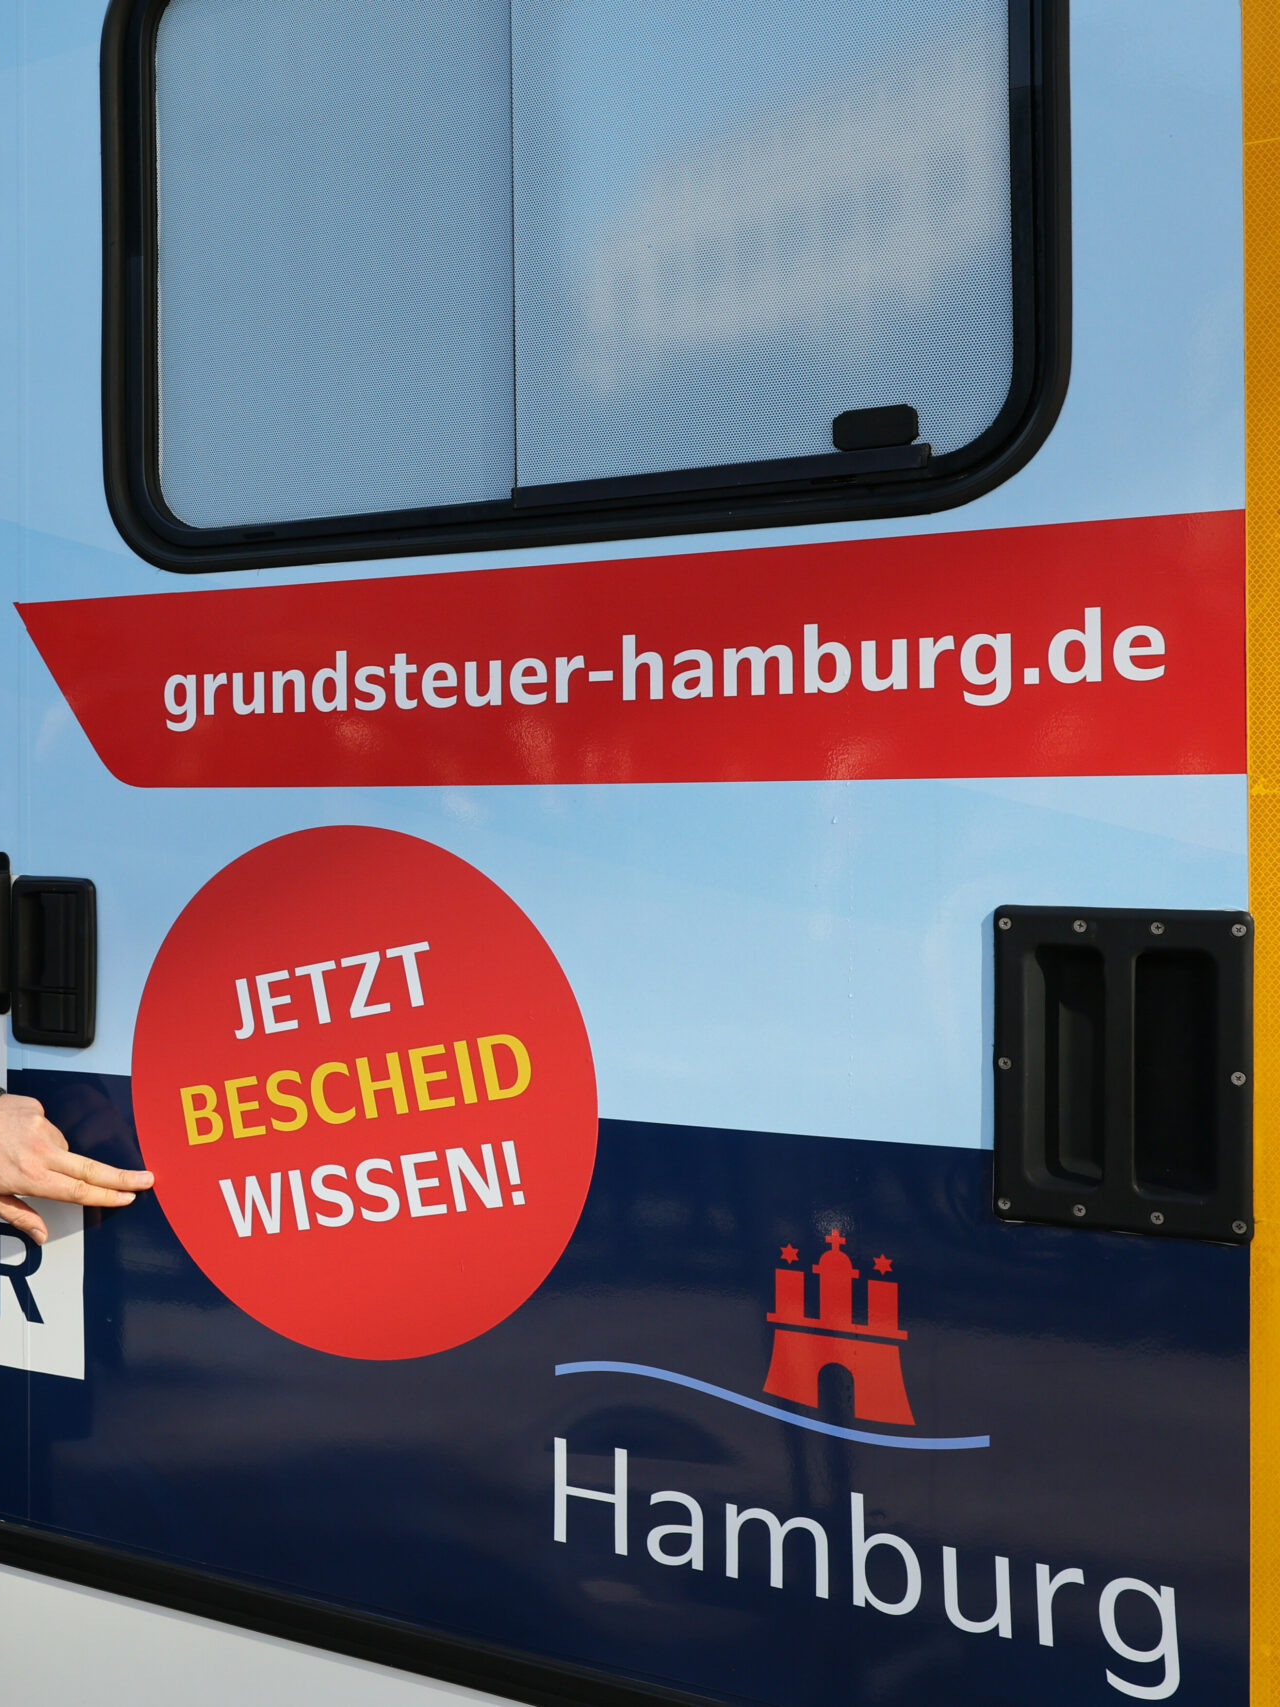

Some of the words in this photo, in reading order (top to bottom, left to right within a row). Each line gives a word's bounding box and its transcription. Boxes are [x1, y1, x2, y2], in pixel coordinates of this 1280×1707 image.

[162, 606, 1168, 733] grundsteuer-hamburg.de
[233, 941, 431, 1040] JETZT
[179, 1033, 533, 1146] BESCHEID
[218, 1140, 526, 1238] WISSEN!
[553, 1436, 1182, 1701] Hamburg
